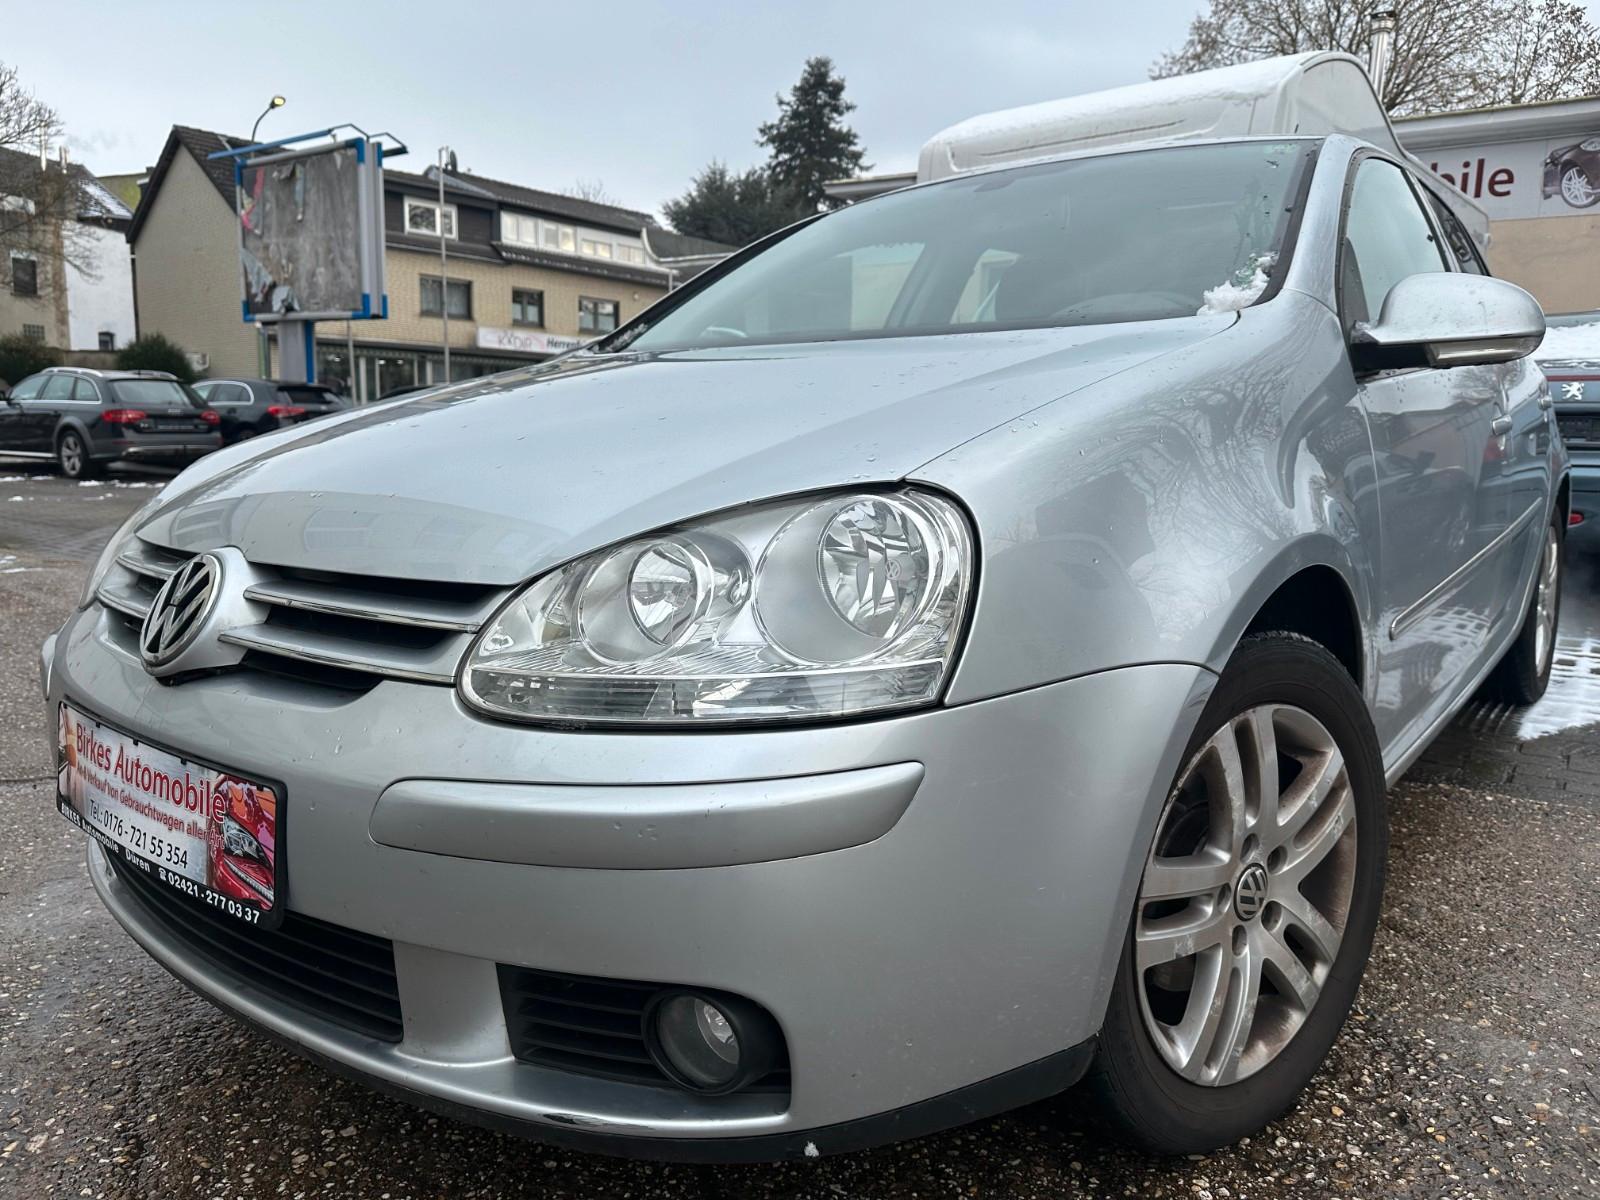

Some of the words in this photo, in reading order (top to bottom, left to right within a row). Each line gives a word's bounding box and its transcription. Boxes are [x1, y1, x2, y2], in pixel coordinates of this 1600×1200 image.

[76, 722, 111, 771] Birkes
[114, 745, 225, 823] Automobile
[104, 809, 123, 836] 0176
[130, 825, 147, 852] 721
[150, 836, 164, 858] 55
[166, 845, 188, 869] 354
[120, 790, 184, 832] Gebrauchtwagen
[187, 820, 208, 840] aller
[168, 872, 198, 898] 02421
[206, 890, 226, 910] 277
[229, 900, 243, 918] 03
[244, 906, 260, 924] 37
